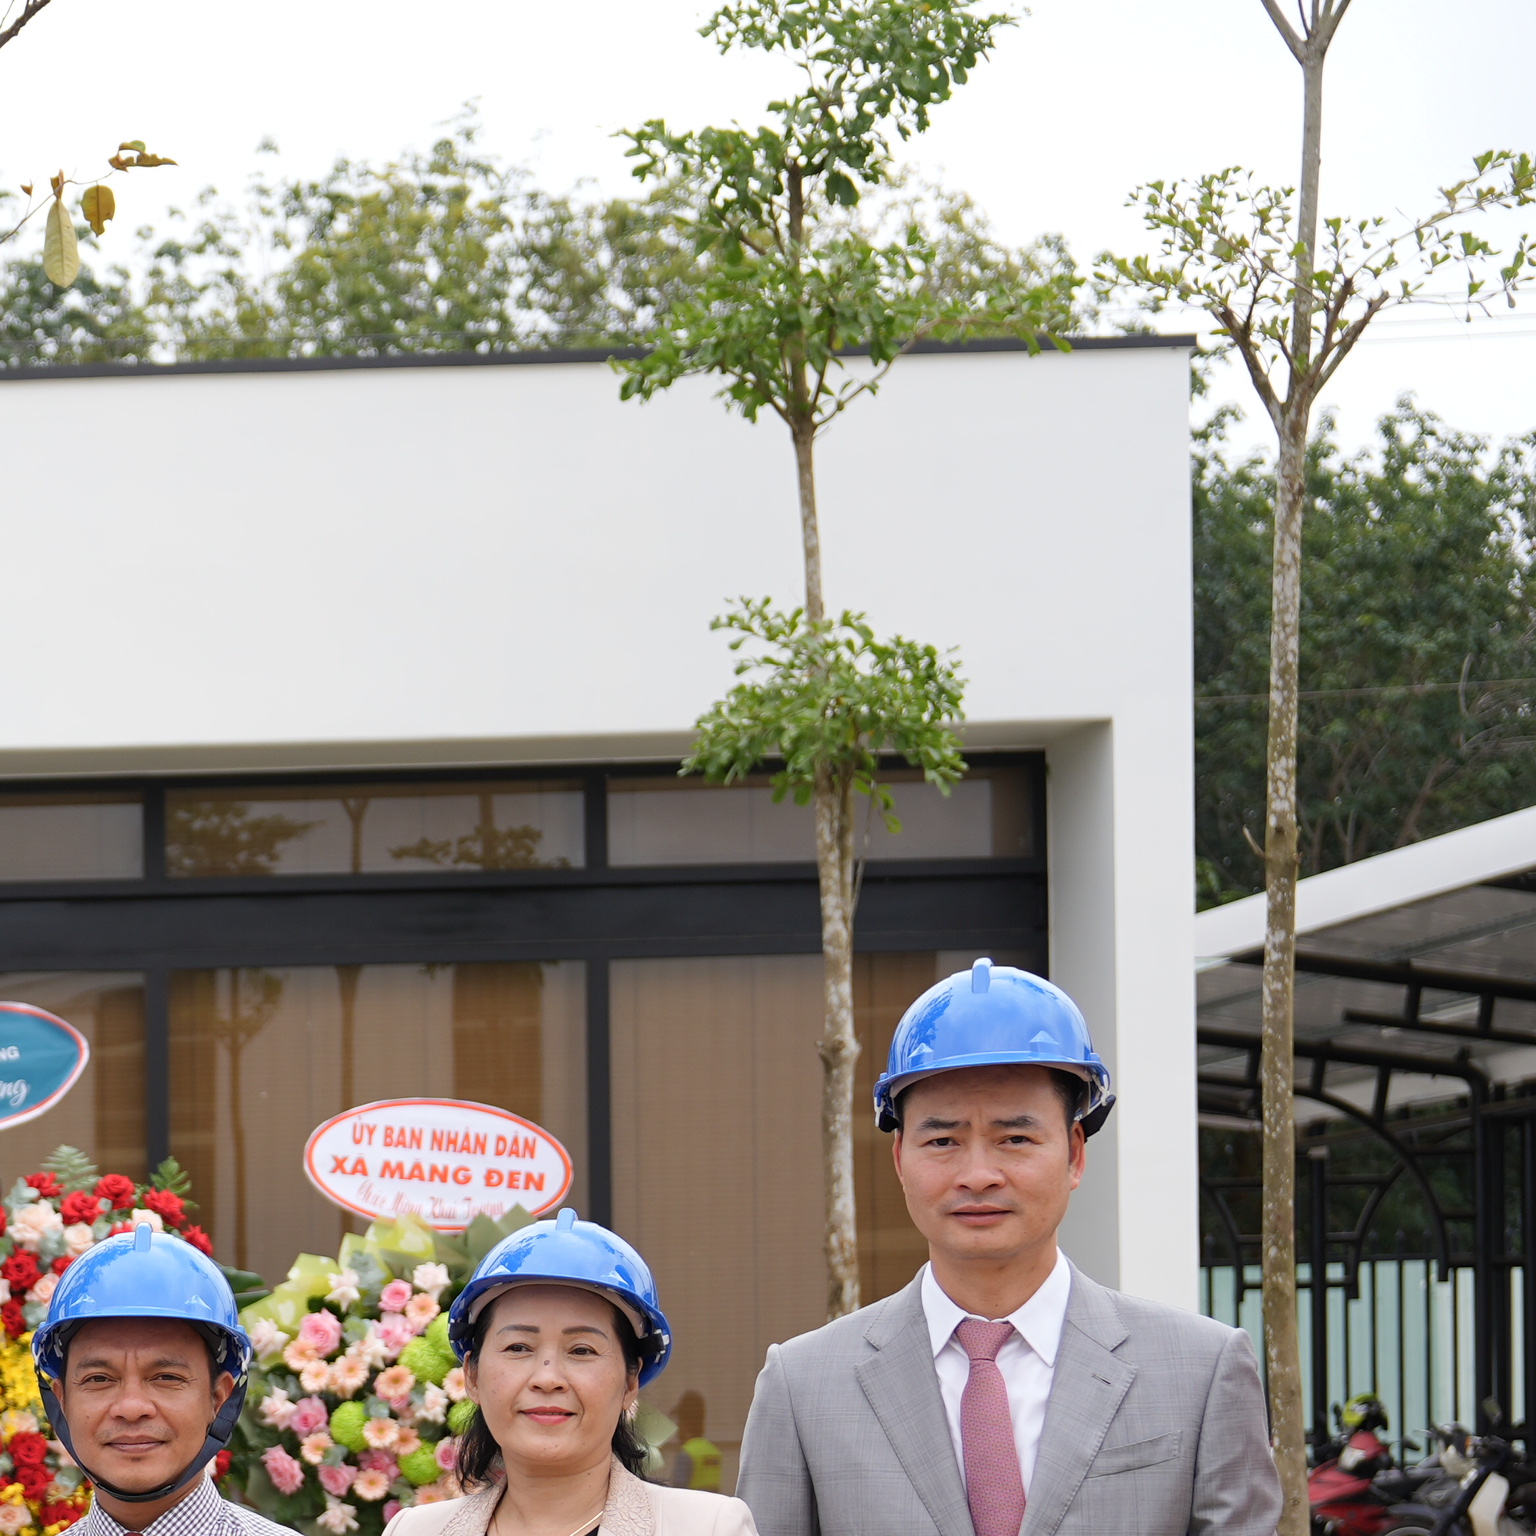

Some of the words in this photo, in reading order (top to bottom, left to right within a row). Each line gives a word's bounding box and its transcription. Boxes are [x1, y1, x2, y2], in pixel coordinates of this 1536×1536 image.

[383, 1124, 424, 1150] BAN
[430, 1126, 487, 1155] NHÂN
[494, 1130, 539, 1159] DÂN
[484, 1168, 546, 1192] ĐEN
